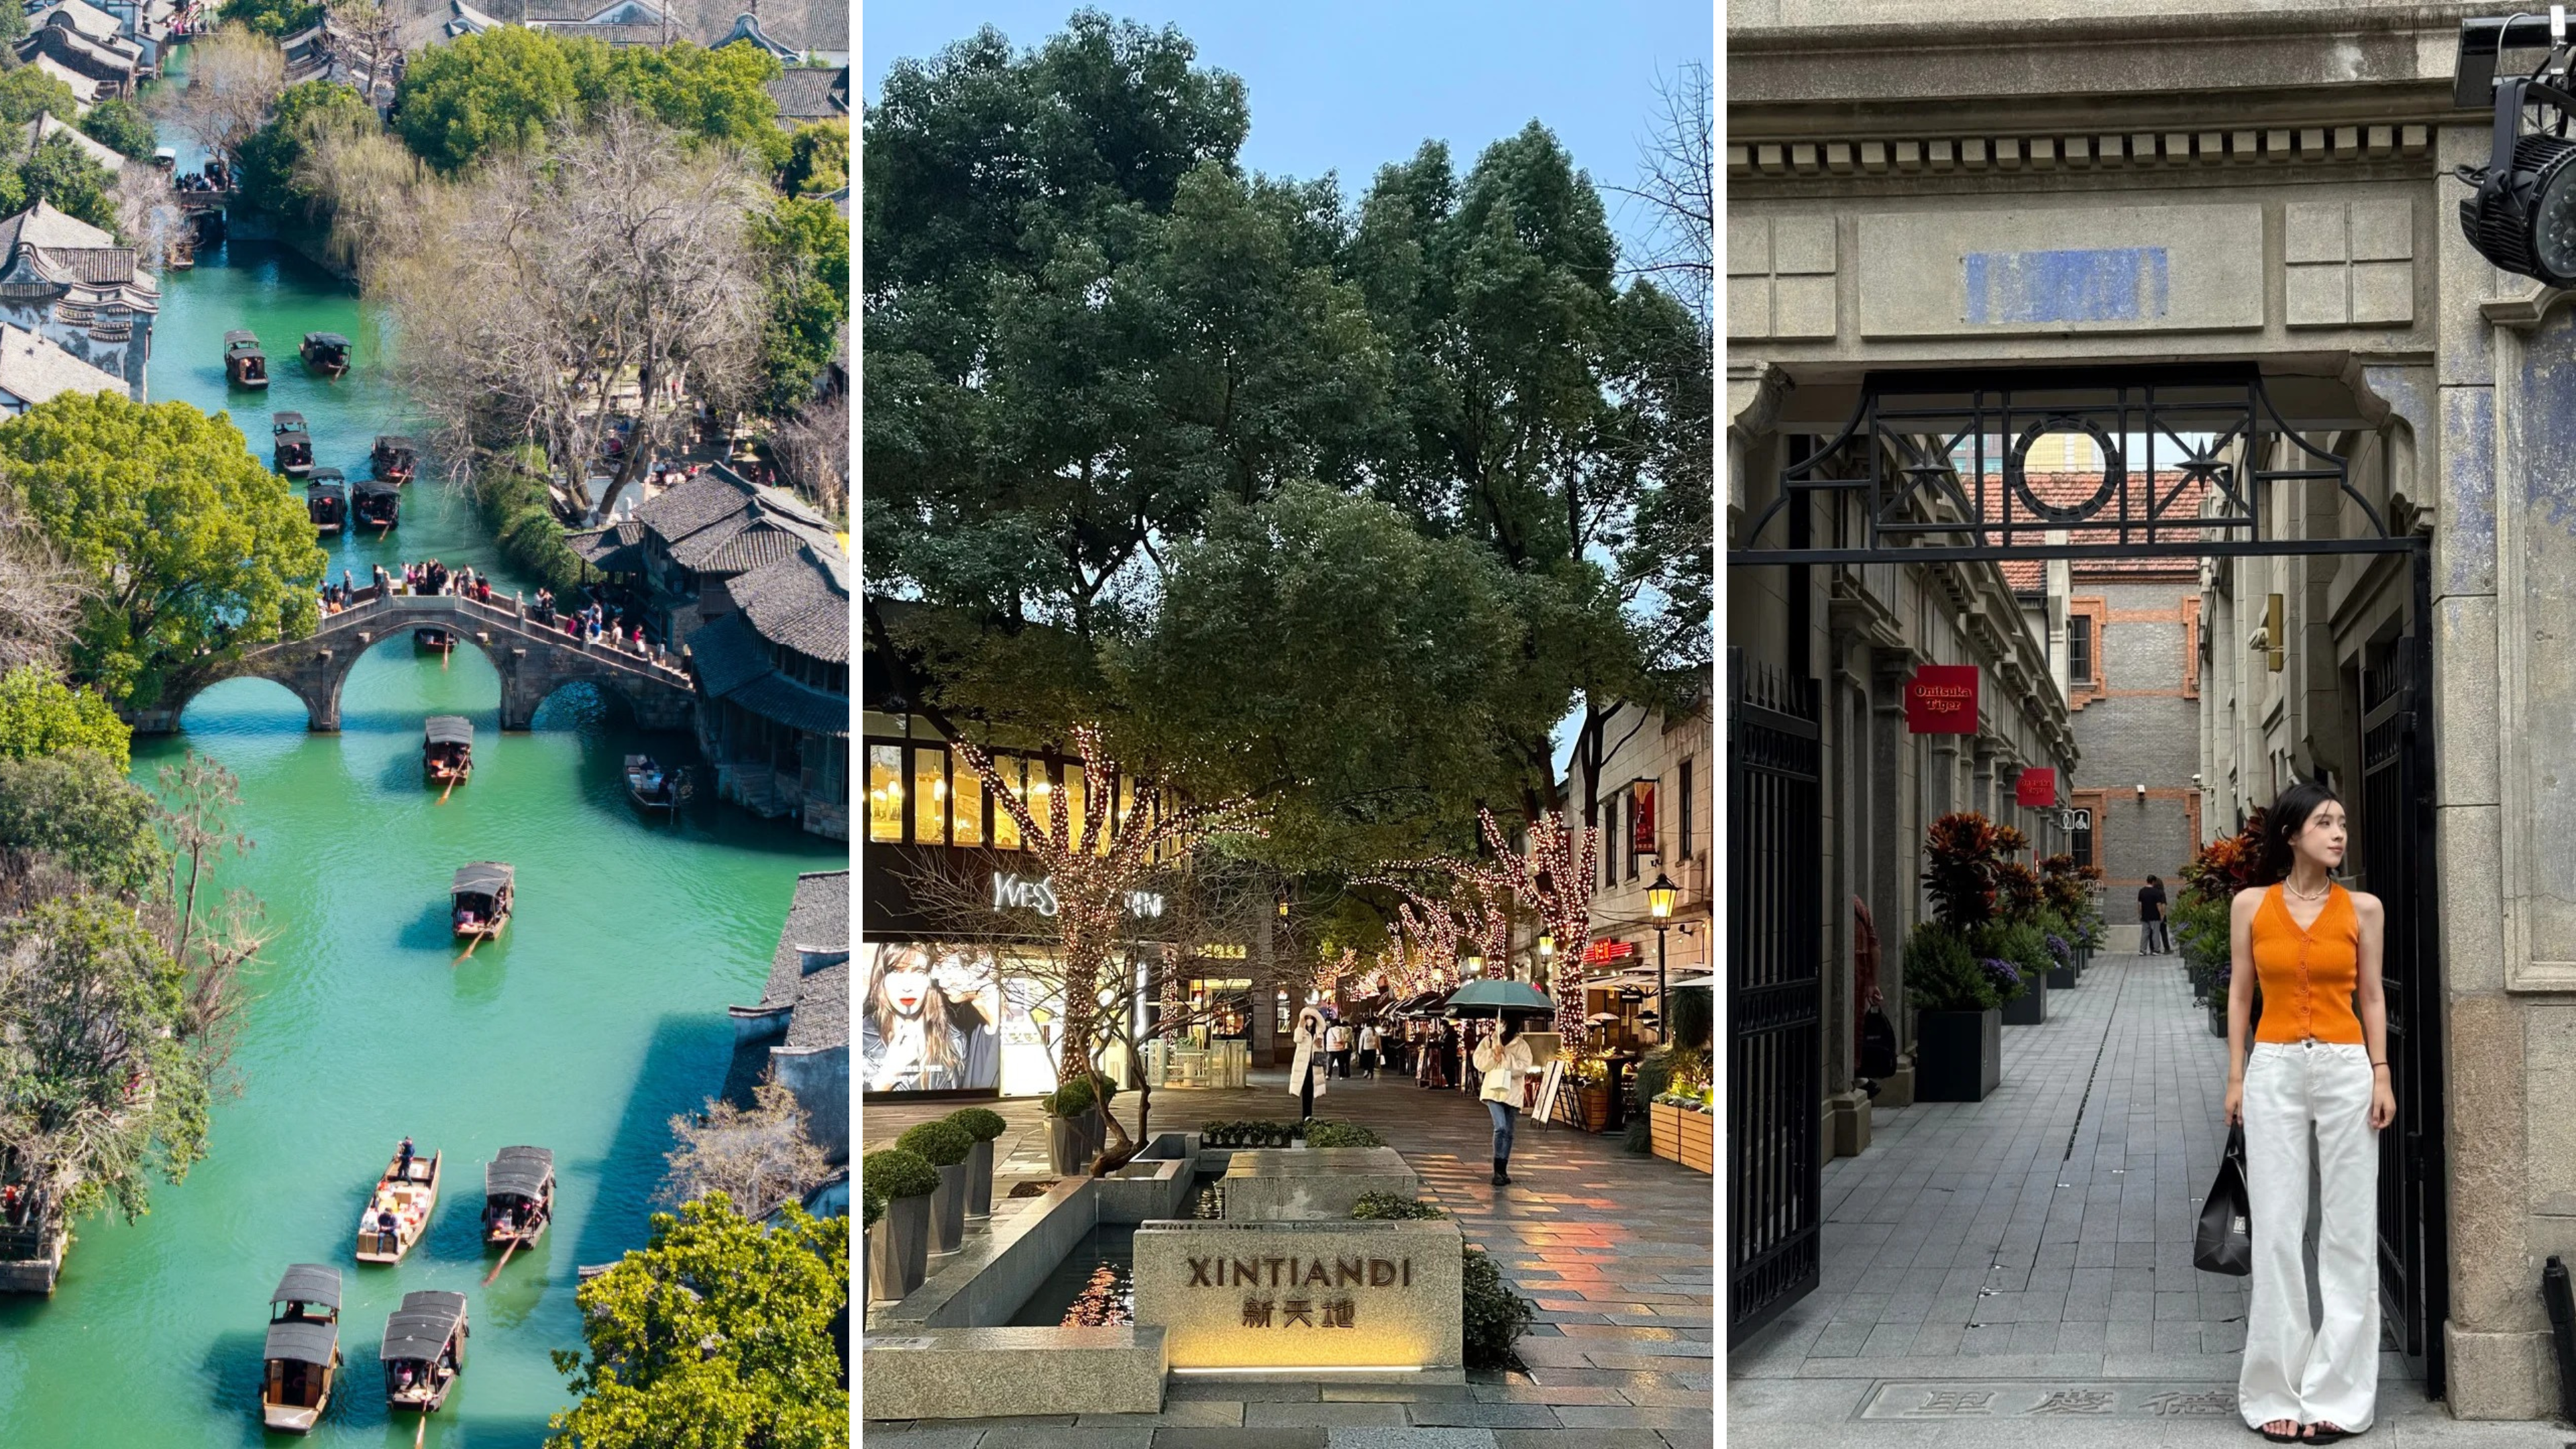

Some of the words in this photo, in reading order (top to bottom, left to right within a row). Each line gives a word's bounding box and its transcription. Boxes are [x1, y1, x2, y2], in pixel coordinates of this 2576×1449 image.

[1915, 685, 1972, 697] Onitsuka
[1926, 698, 1961, 712] Tiger
[1188, 1257, 1409, 1287] XINTIANDI
[1242, 1298, 1355, 1328] 新天地
